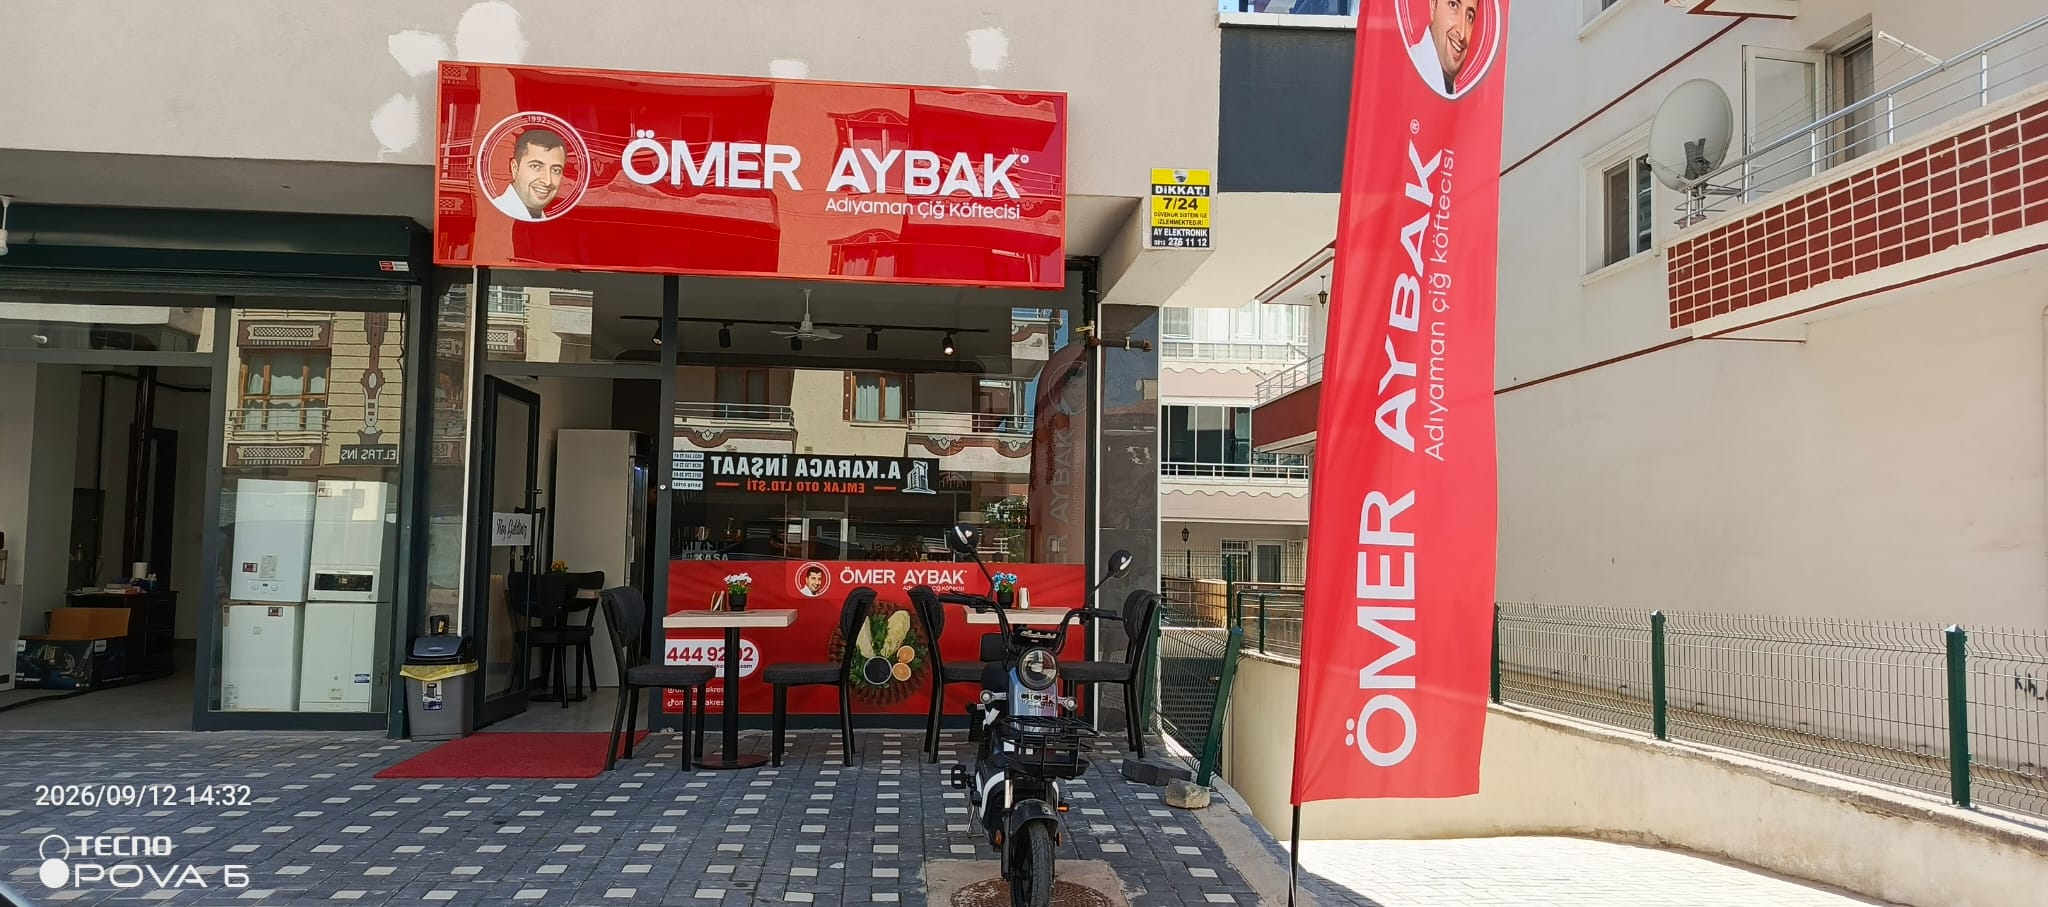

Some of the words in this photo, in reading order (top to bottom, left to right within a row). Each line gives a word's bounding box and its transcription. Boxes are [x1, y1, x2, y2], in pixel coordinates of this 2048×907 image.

[527, 115, 548, 124] 1992
[621, 129, 803, 191] ÖMER
[825, 147, 1021, 199] AYBAK
[825, 197, 914, 216] Adıyaman
[917, 200, 945, 220] Çiğ
[949, 203, 1021, 220] Köftecisi
[1163, 197, 1199, 210] 7/24
[1430, 148, 1455, 263] köftecisi
[1153, 228, 1164, 237] AY
[1168, 237, 1183, 247] 276
[1185, 238, 1195, 247] 11
[1197, 238, 1207, 247] 12
[1375, 139, 1443, 450] AYBAK
[1429, 272, 1452, 313] çiğ
[1424, 321, 1449, 462] Adıyaman
[839, 566, 896, 585] ÖMER
[902, 569, 965, 585] AYBAK
[1345, 489, 1417, 767] ÖMER
[666, 646, 703, 662] 444
